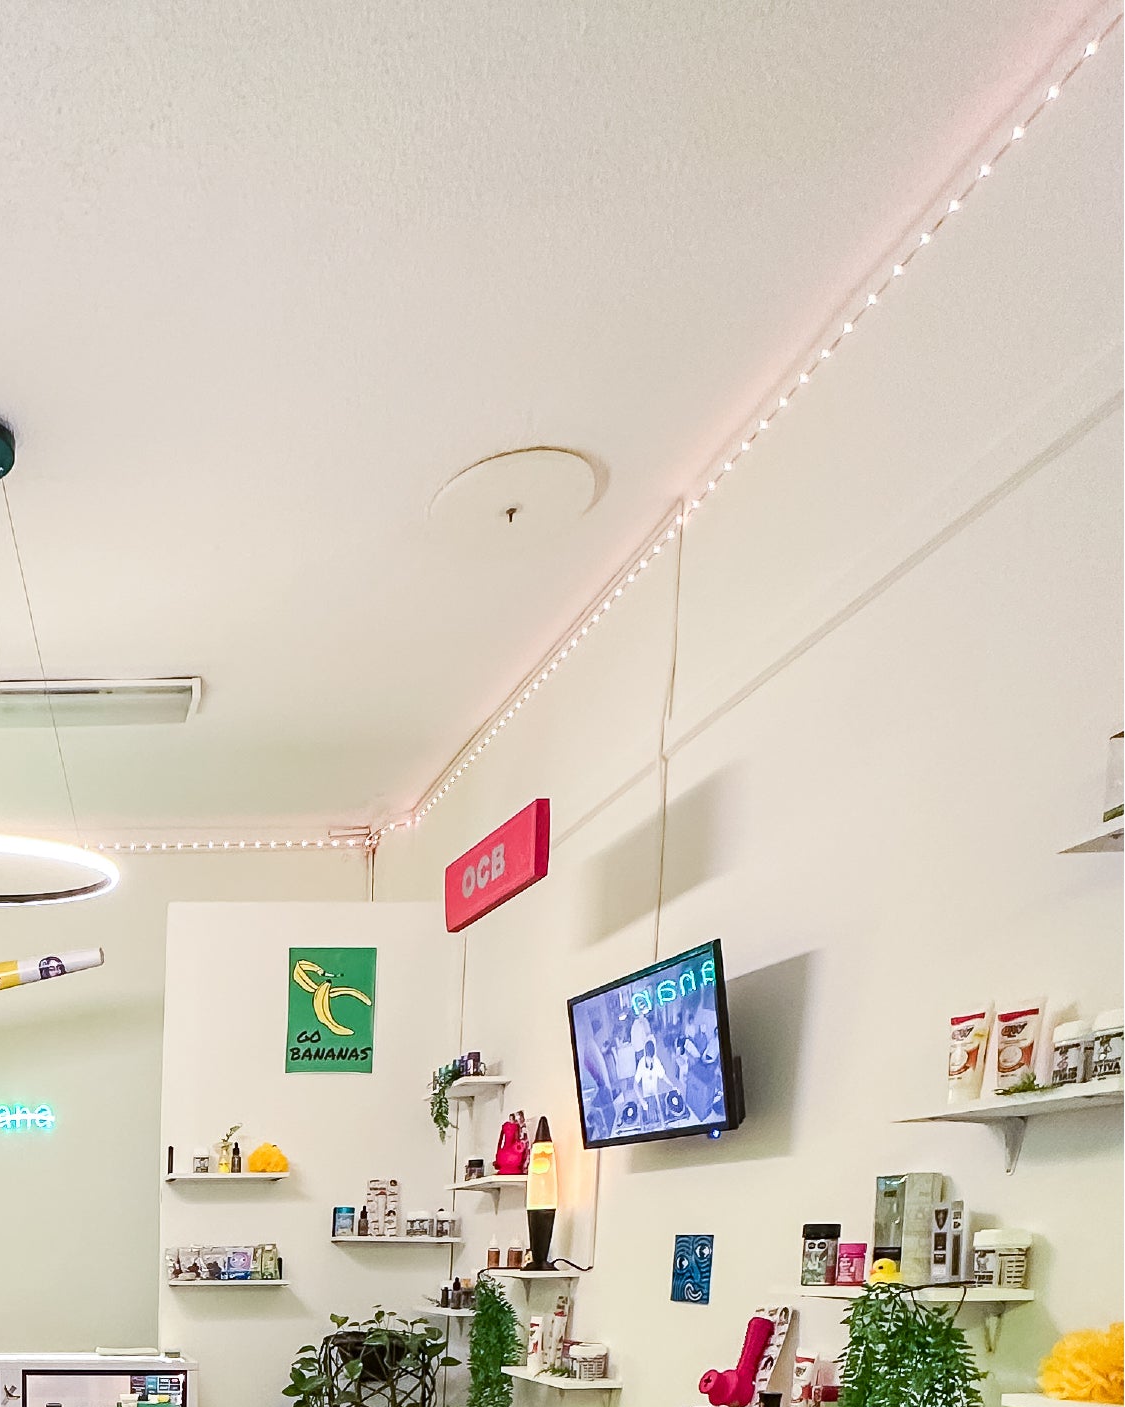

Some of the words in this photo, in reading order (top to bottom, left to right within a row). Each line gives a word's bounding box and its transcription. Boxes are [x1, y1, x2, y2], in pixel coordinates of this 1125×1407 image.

[462, 843, 506, 898] OCB
[297, 1031, 321, 1043] GO
[290, 1047, 372, 1061] BANANAS
